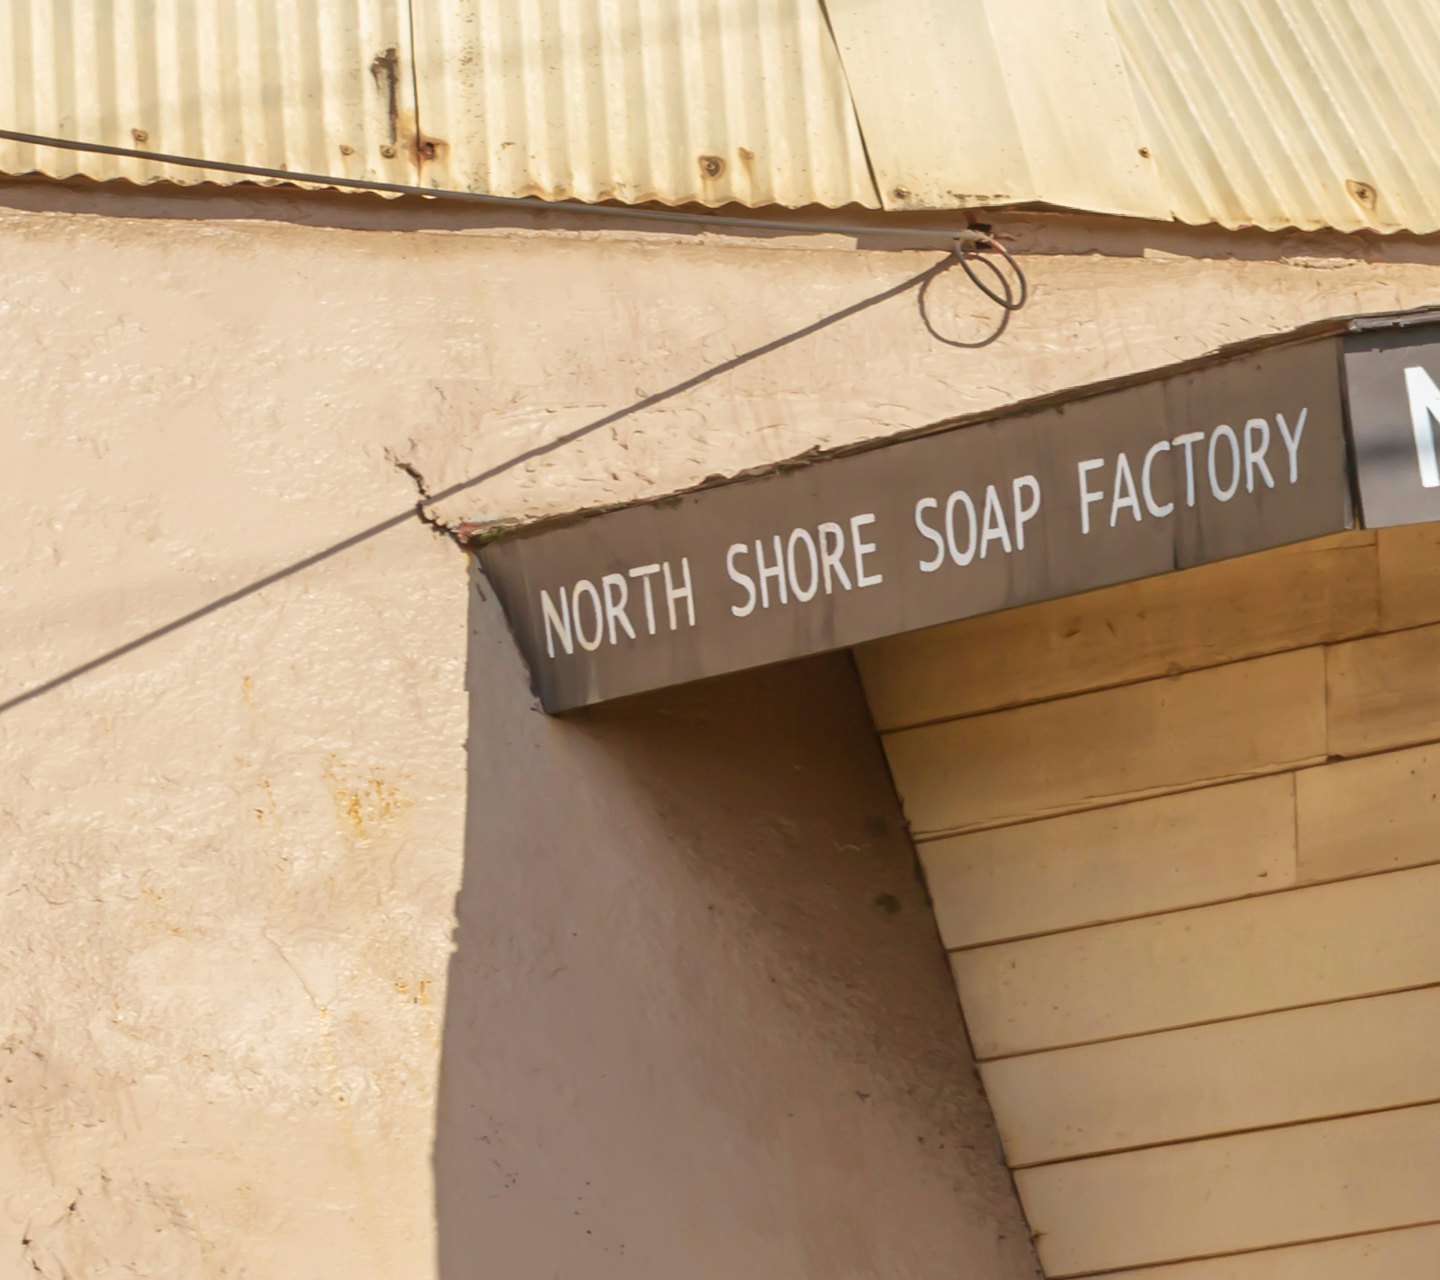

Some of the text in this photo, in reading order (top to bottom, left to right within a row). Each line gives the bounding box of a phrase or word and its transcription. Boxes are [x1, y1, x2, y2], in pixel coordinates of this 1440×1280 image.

[540, 408, 1310, 659] NORTH SHORE SOAP FACTORY
